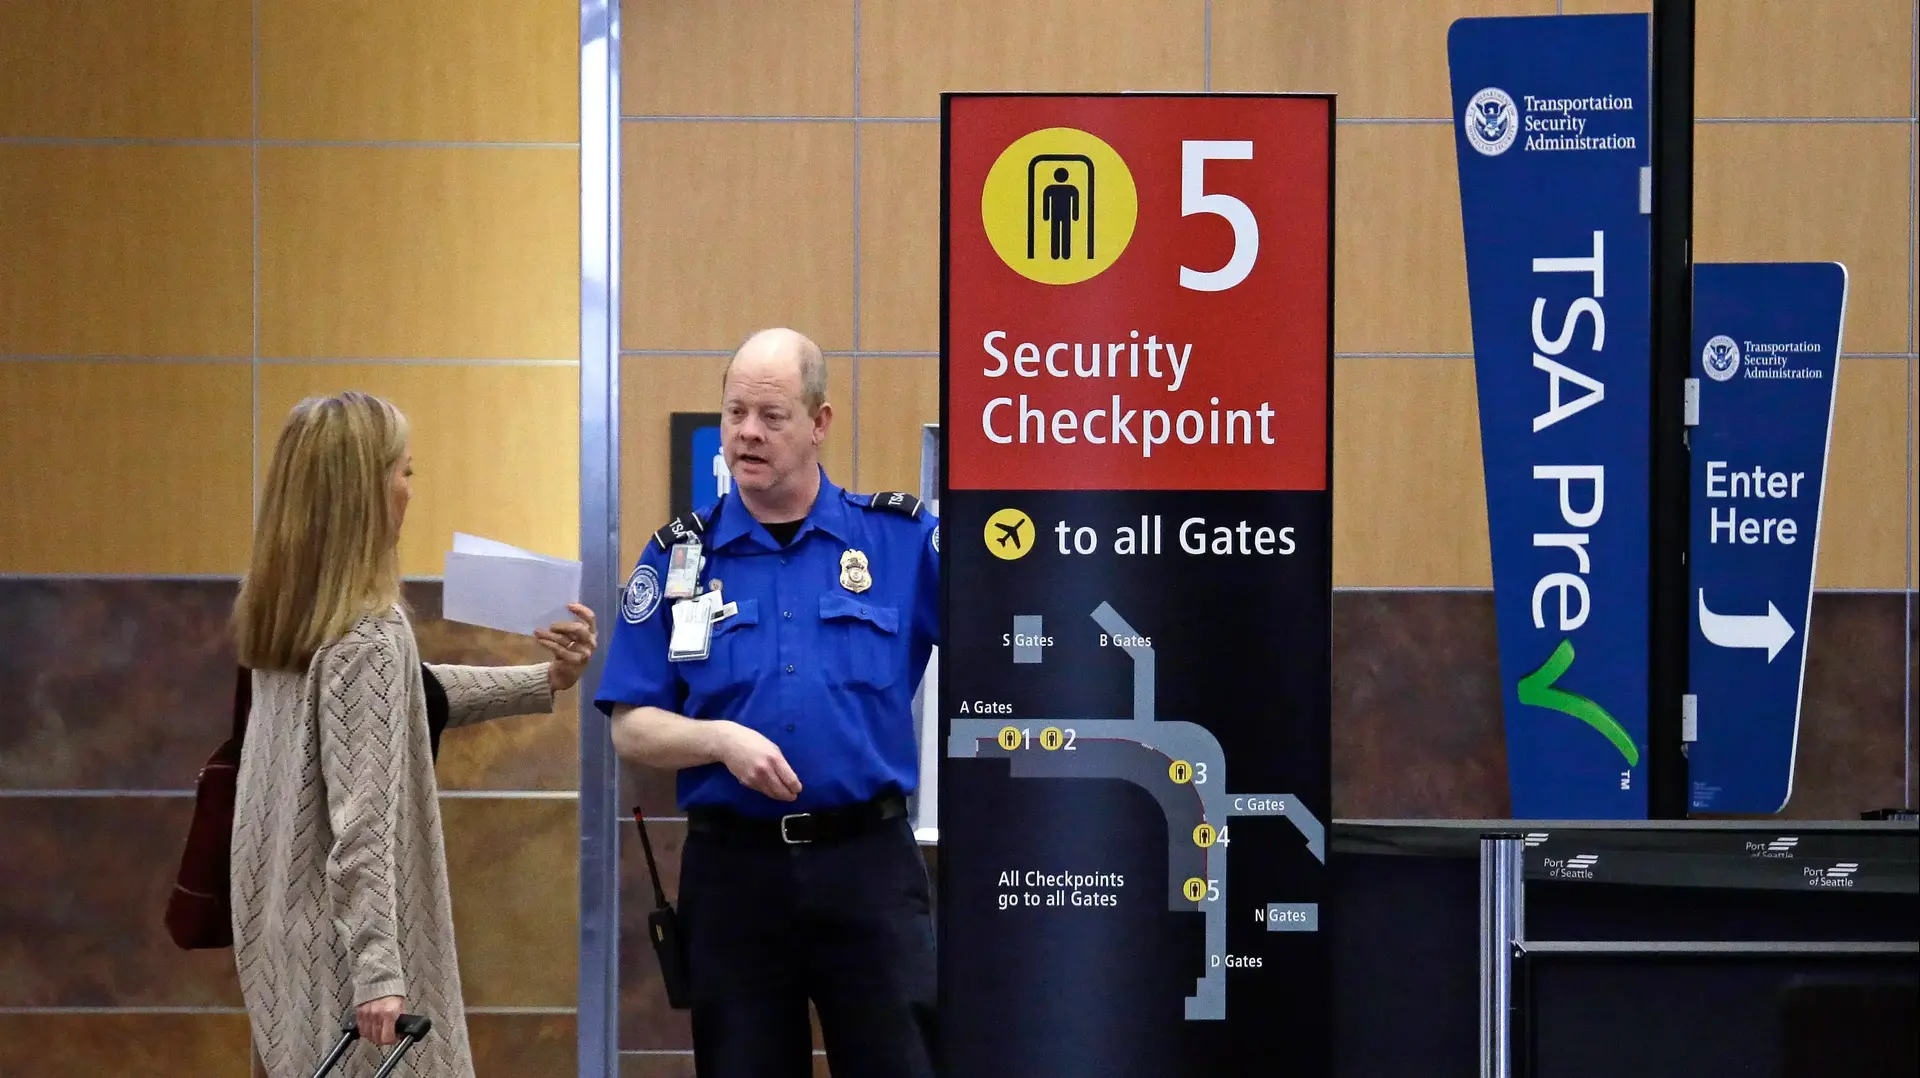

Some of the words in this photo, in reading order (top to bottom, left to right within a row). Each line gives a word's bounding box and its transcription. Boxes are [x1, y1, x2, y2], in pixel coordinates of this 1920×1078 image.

[1524, 94, 1633, 114] Transportation
[1524, 114, 1586, 133] Security
[1524, 133, 1636, 151] Administration
[1179, 140, 1259, 292] 5
[1532, 230, 1605, 434] TSA
[1744, 341, 1821, 355] Transportation
[983, 330, 1193, 392] Security
[1744, 354, 1787, 367] Security
[1744, 367, 1822, 379] Administration
[982, 395, 1276, 458] Checkpoint
[1706, 461, 1805, 499] Enter
[669, 516, 688, 539] TSA
[1055, 520, 1098, 555] to
[1114, 514, 1161, 555] all
[1179, 517, 1296, 555] Gates
[1710, 507, 1798, 545] Here
[1531, 465, 1604, 631] Pre
[1002, 634, 1010, 647] S
[1014, 634, 1054, 647] Gates
[1100, 634, 1108, 647] B
[1112, 634, 1152, 647] Gates
[959, 701, 970, 714] A
[973, 701, 1013, 714] Gates
[1021, 729, 1030, 750] 1
[1063, 729, 1077, 750] 2
[1194, 762, 1207, 785] 3
[1234, 798, 1243, 811] C
[1247, 798, 1285, 811] Gates
[1216, 826, 1230, 847] 4
[1745, 842, 1765, 850] Port
[1544, 858, 1564, 868] Port
[1803, 867, 1823, 877] Port
[998, 871, 1019, 887] All
[1025, 871, 1124, 891] Checkpoints
[1550, 868, 1559, 877] of
[1561, 868, 1593, 879] Seattle
[1809, 877, 1818, 886] of
[1821, 877, 1853, 887] Seattle
[998, 894, 1019, 910] go
[1023, 892, 1040, 906] to
[1046, 890, 1065, 906] all
[1072, 891, 1117, 906] Gates
[1207, 879, 1220, 902] 5
[1255, 909, 1264, 922] N
[1269, 909, 1306, 922] Gates
[1211, 955, 1220, 968] D
[1224, 955, 1263, 968] Gates
